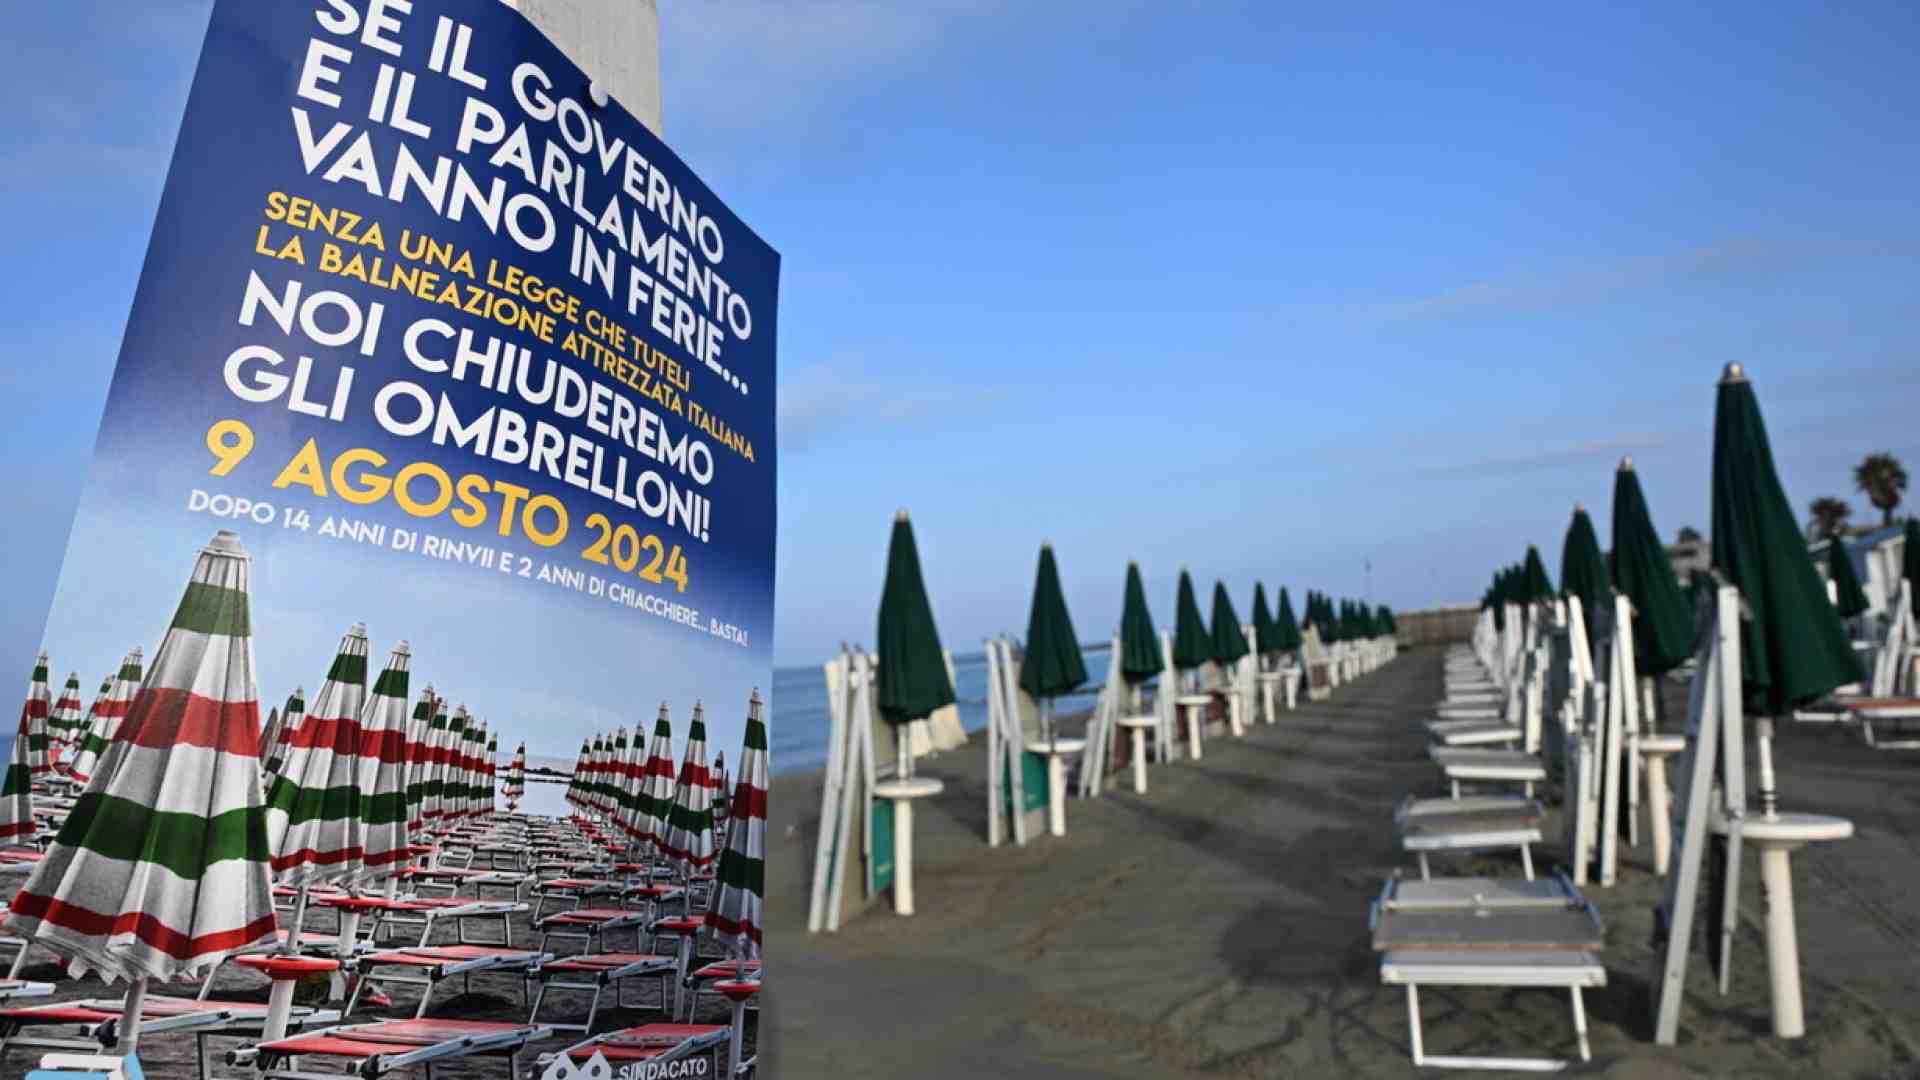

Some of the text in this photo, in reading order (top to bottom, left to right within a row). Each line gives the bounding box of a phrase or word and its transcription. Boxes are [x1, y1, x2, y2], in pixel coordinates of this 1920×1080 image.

[291, 106, 557, 254] VANNO
[570, 225, 616, 299] IN
[297, 37, 753, 340] E IL PARLAMENTO
[315, 0, 724, 265] SE IL GOVERNO
[238, 269, 715, 485] NOI CHIUDEREMO
[255, 225, 756, 463] LA BALNEAZIONE ATTREZZATA ITALIANA
[265, 191, 691, 392] SENZA UNA LEGGE CHE TUTELI
[206, 419, 689, 593] 9 AGOSTO 2024
[223, 345, 711, 544] GLI OMBRELLONI!
[188, 489, 275, 525] DOPO
[282, 506, 310, 533] 14
[317, 516, 385, 545] ANNI
[392, 529, 416, 551] DI
[422, 534, 494, 569] RINVII
[499, 552, 513, 573] E
[519, 557, 532, 579] 2
[536, 562, 585, 593] ANNI
[590, 576, 605, 597] DI
[710, 616, 748, 648] BASTA!
[618, 1058, 708, 1080] SINDACATO
